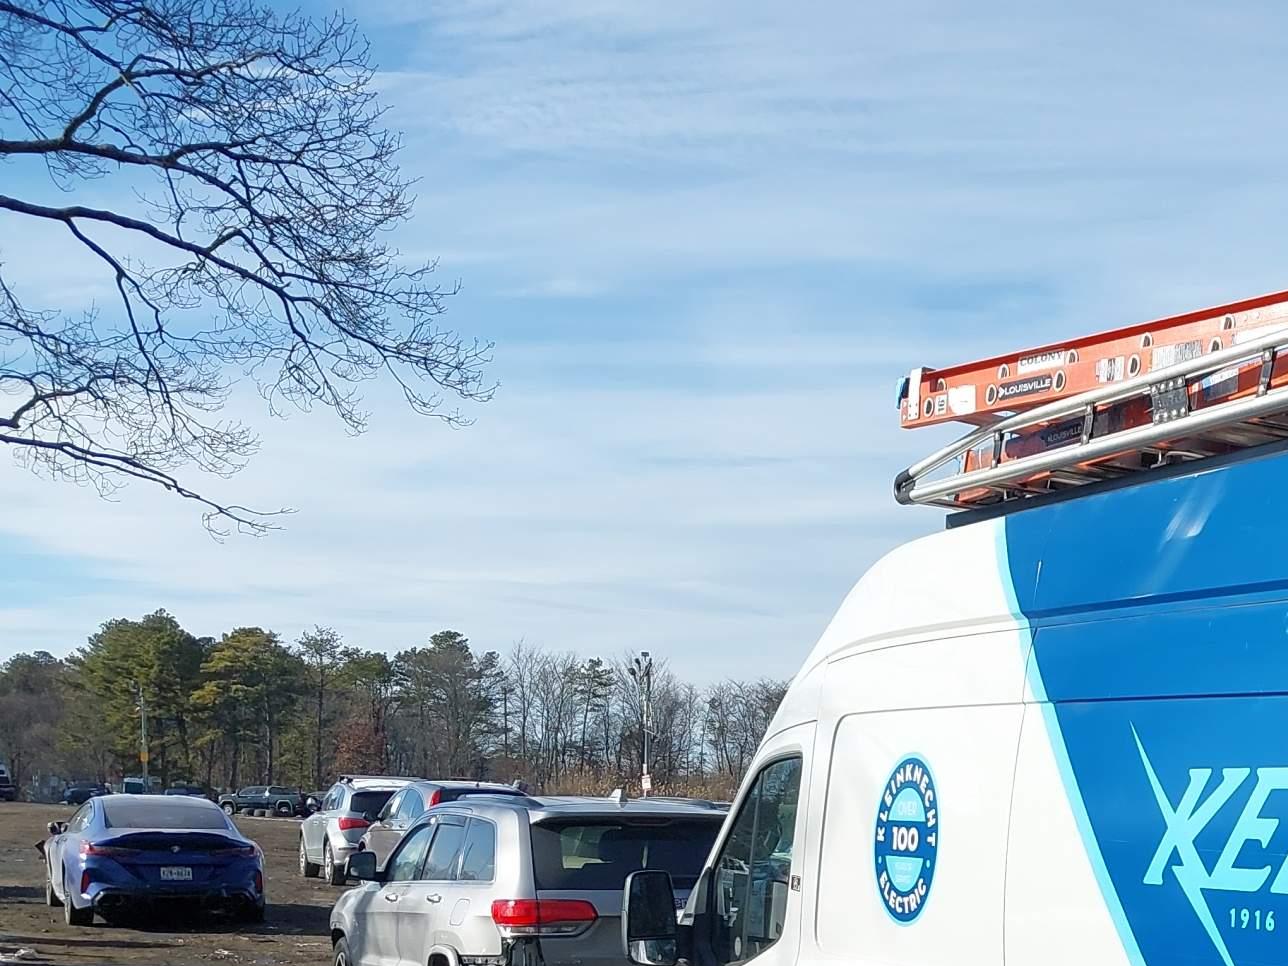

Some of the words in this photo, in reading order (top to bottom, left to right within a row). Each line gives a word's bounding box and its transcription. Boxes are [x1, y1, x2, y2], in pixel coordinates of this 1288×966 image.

[1019, 350, 1064, 367] COLONY
[1004, 377, 1052, 396] LOUISVILLE
[877, 763, 936, 848] KLEINKNECHT
[892, 827, 919, 852] 100
[879, 870, 927, 914] ELECTRIC
[1229, 908, 1275, 931] 1916
